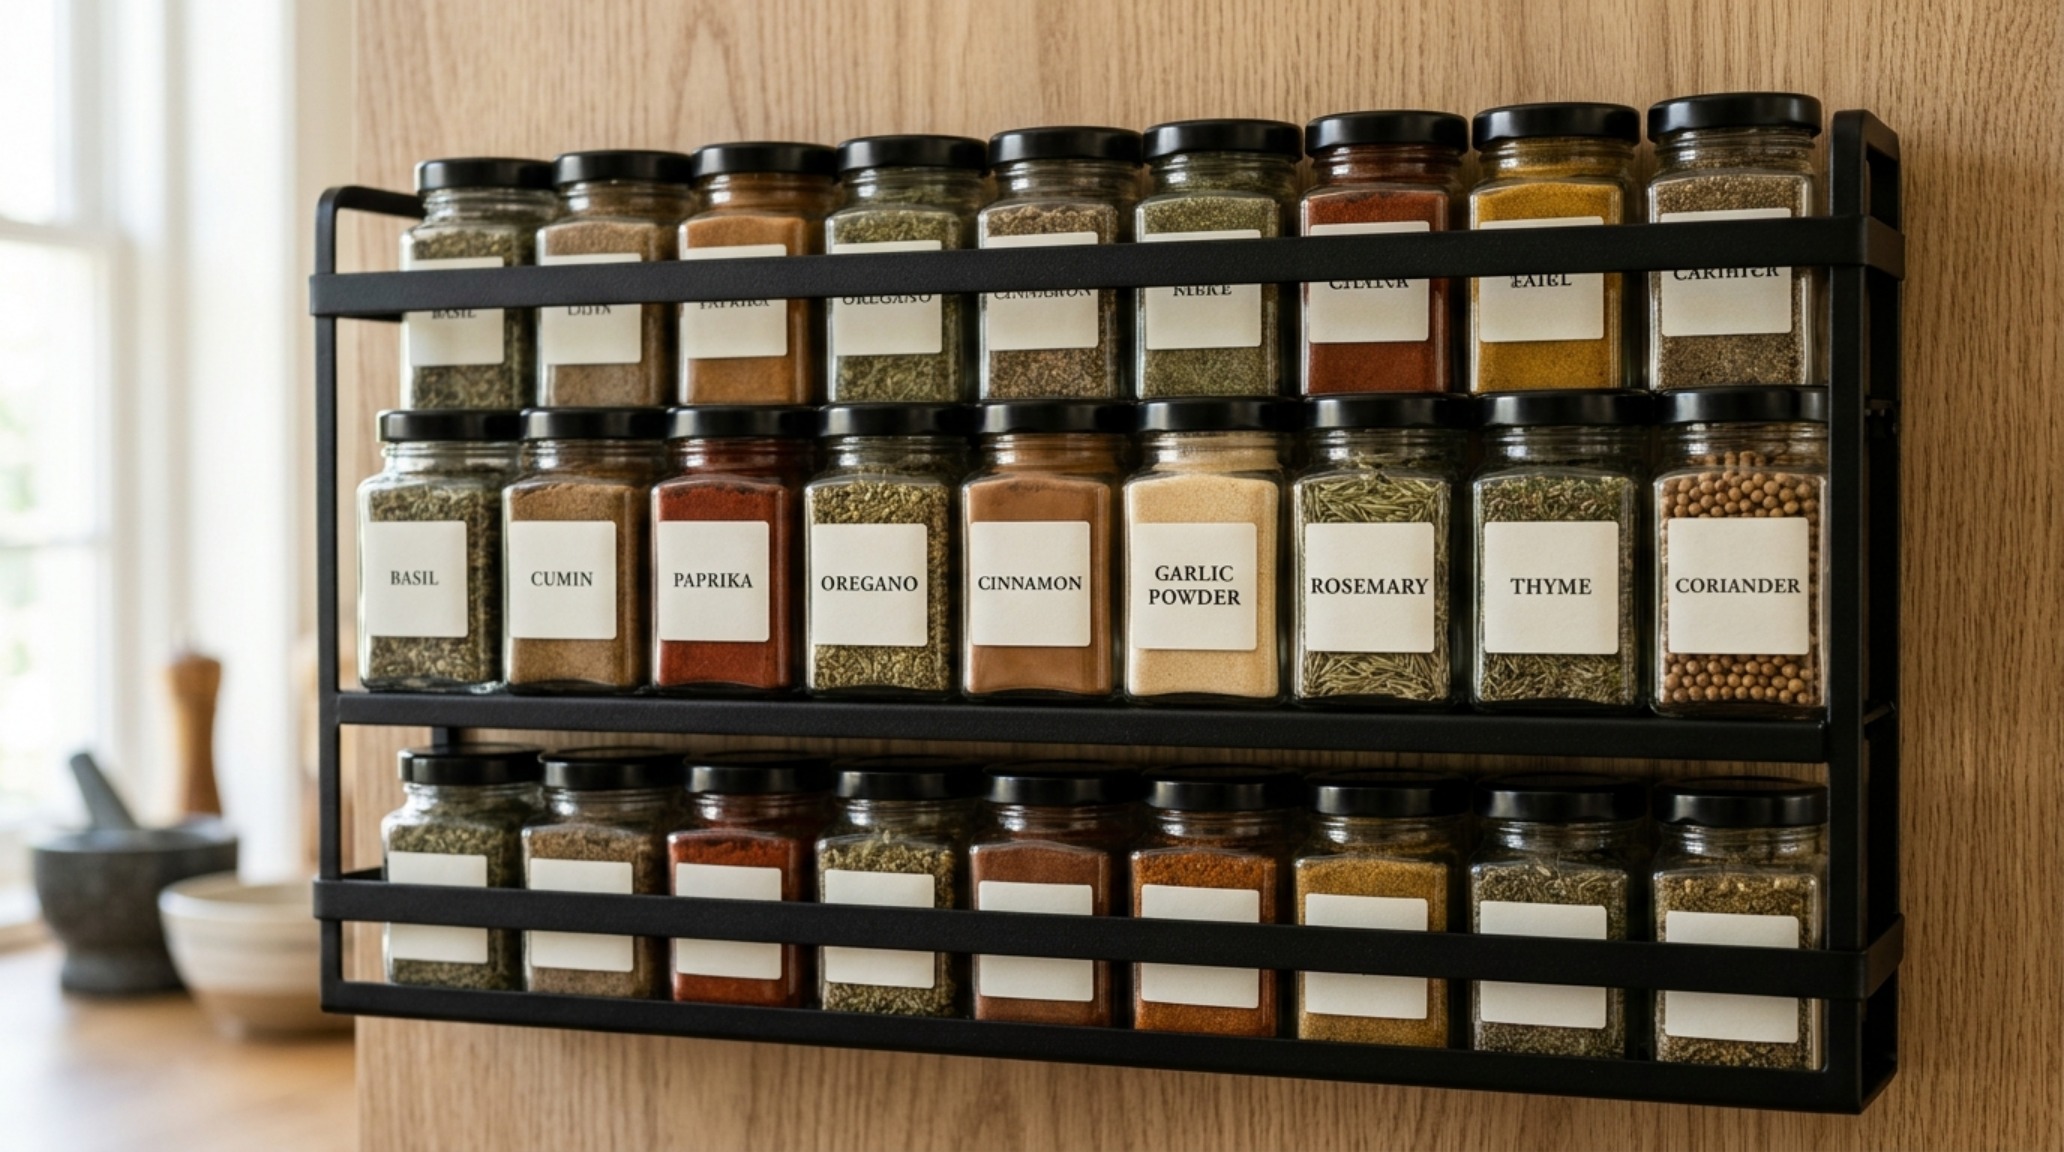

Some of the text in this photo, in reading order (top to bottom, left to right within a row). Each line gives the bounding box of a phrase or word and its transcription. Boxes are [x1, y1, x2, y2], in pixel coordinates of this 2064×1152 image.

[389, 570, 439, 586] BASIL
[530, 571, 594, 587] CUMIN
[673, 572, 754, 589] PAPRIKA
[1154, 565, 1234, 583] GARLIC
[820, 575, 919, 592] OREGANO
[977, 575, 1083, 591] CINNAMON
[1310, 578, 1430, 596] ROSEMARY
[1511, 578, 1592, 595] THYME
[1675, 578, 1801, 594] CORIANDER
[1148, 588, 1241, 606] POWDER
